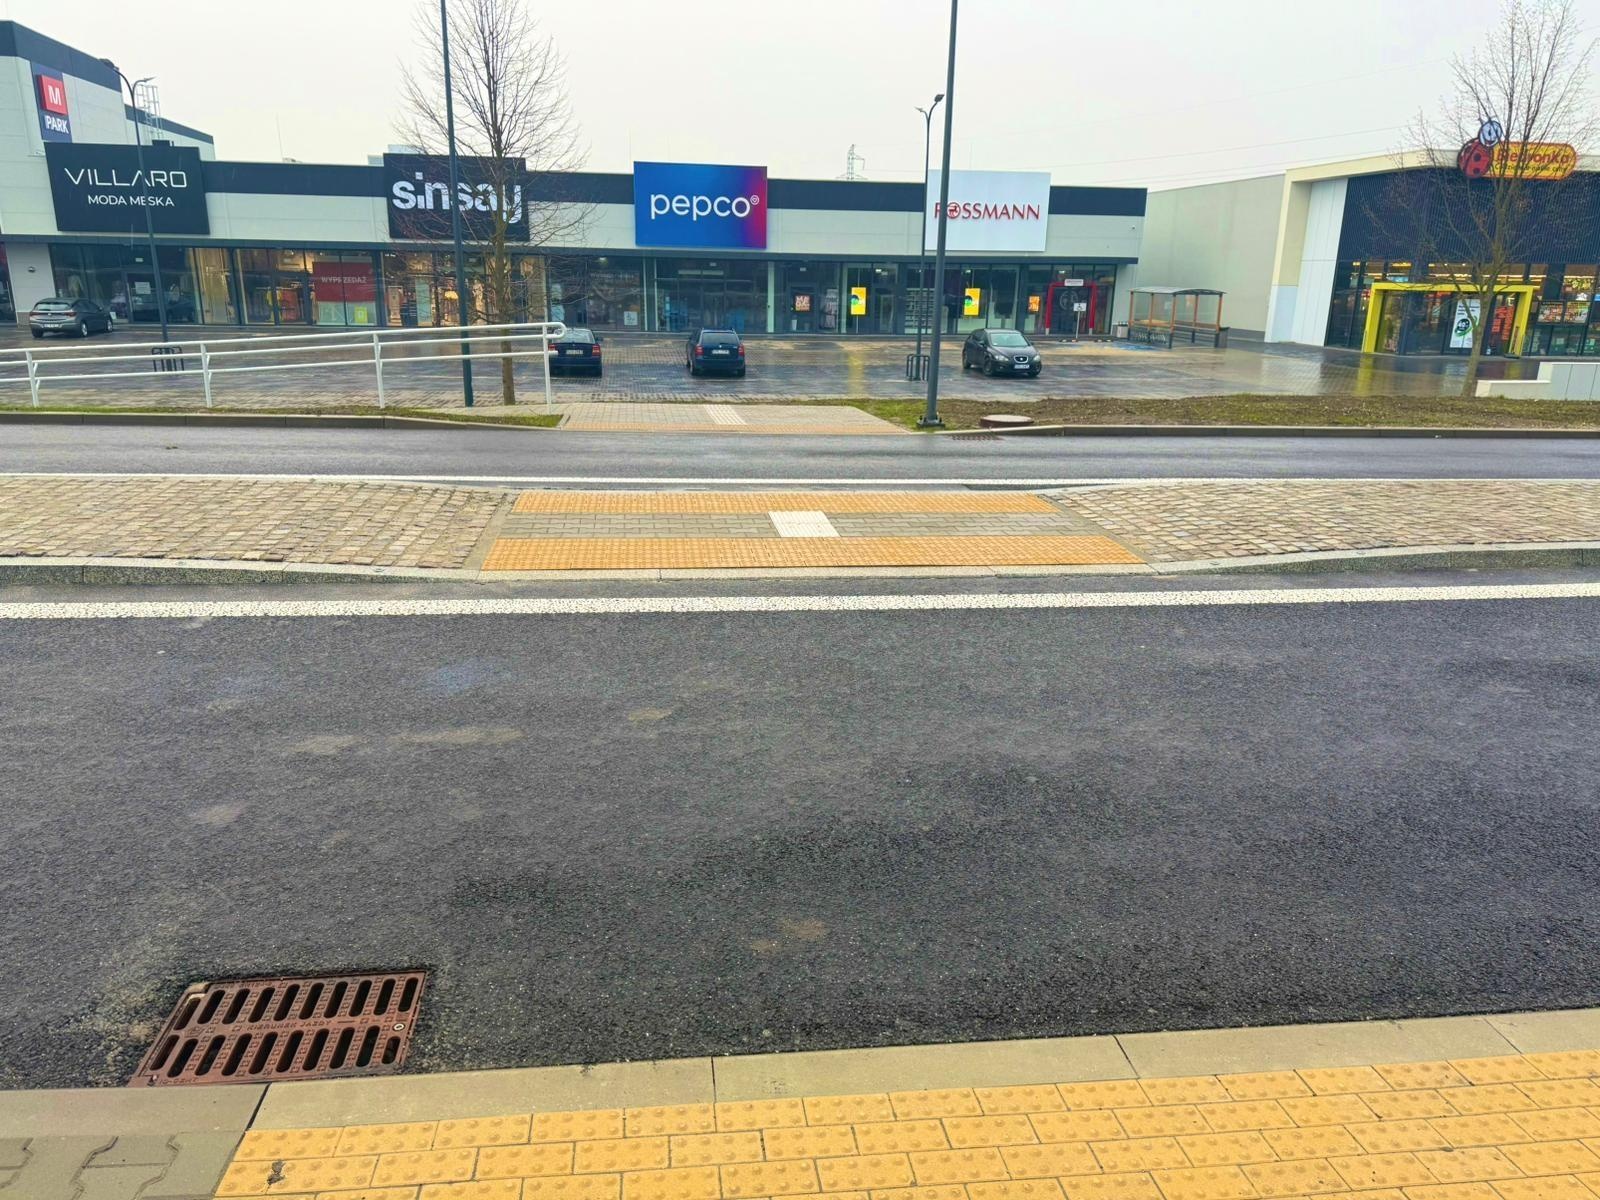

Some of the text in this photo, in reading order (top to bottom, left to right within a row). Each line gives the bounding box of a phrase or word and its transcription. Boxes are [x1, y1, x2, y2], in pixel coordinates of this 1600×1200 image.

[47, 84, 62, 106] M
[44, 115, 69, 134] PARK
[64, 167, 187, 188] VILLARO
[88, 194, 128, 206] MODA
[392, 171, 522, 224] sinsay
[650, 194, 751, 221] pepco
[300, 1020, 331, 1028] JAZDY
